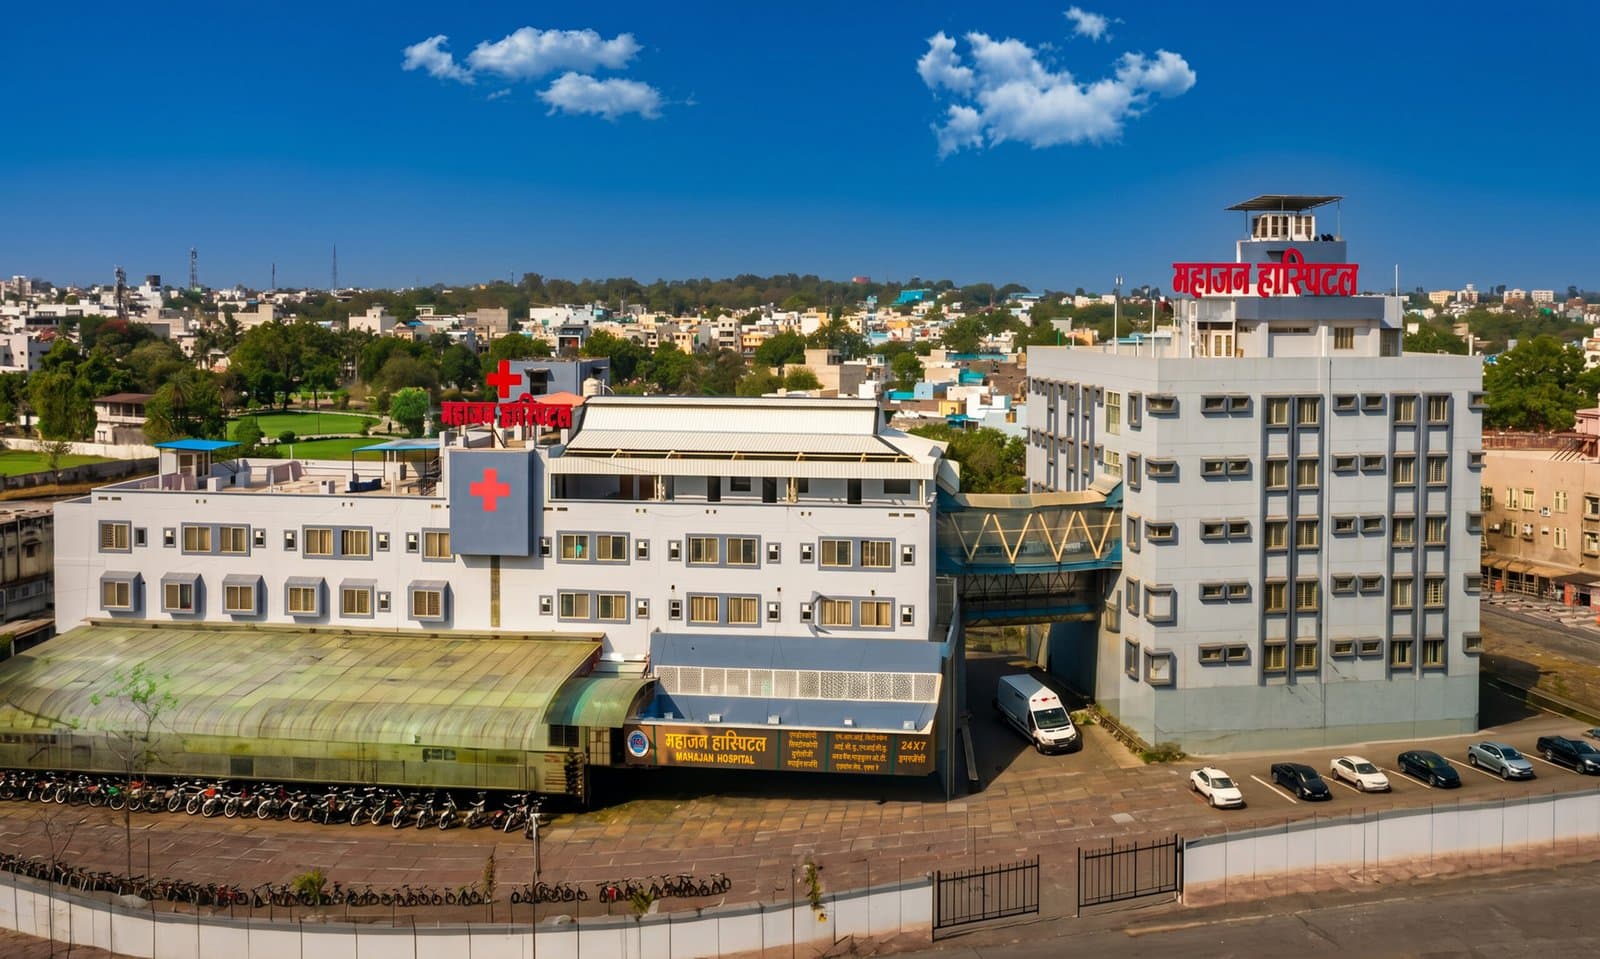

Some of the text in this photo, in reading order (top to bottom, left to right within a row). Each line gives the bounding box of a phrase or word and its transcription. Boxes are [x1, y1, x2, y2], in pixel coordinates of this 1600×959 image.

[1172, 263, 1251, 298] महाजन
[441, 401, 497, 426] महाजन
[665, 733, 708, 749] महाजन
[901, 740, 927, 751] 24X7
[676, 751, 755, 765] MAHAJAN HOSPITAL
